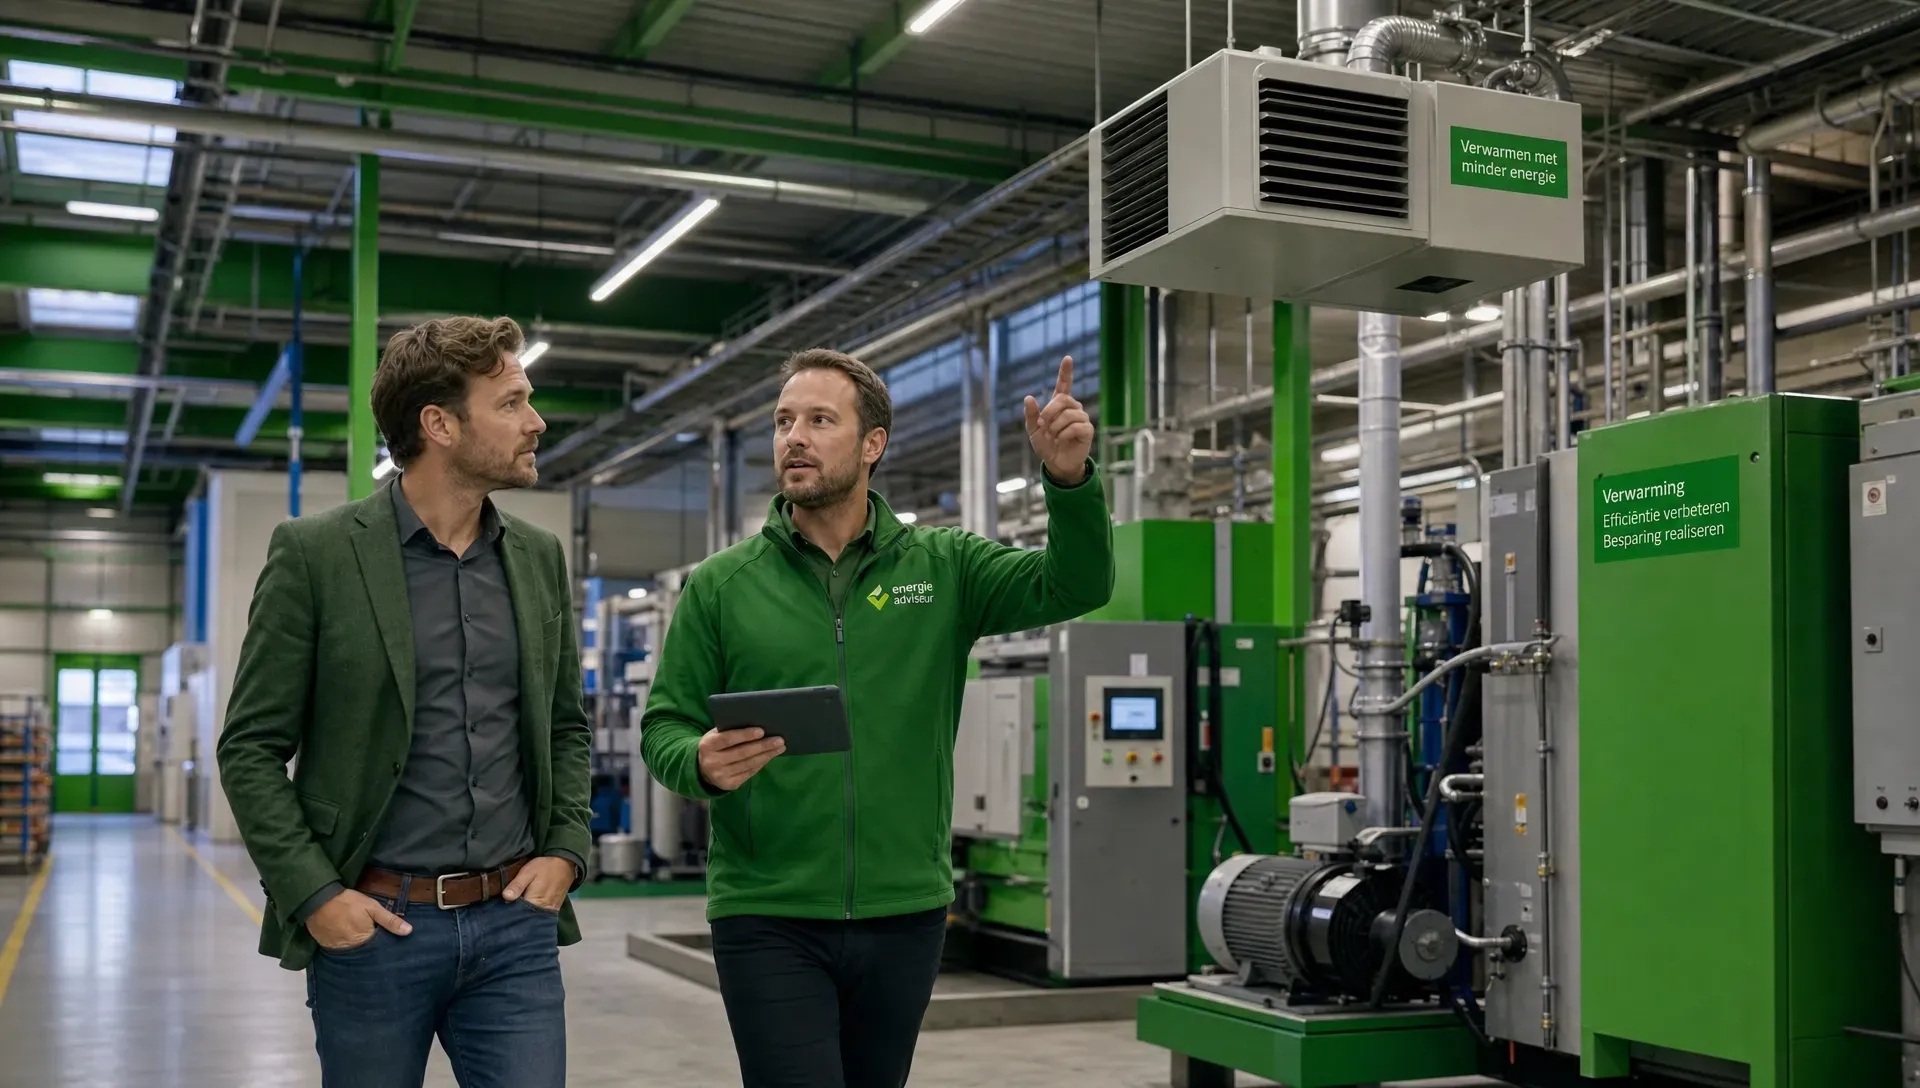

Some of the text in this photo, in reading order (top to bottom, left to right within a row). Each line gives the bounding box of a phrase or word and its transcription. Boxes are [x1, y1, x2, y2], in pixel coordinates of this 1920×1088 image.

[1460, 139, 1558, 166] Verwarmen met
[1462, 160, 1556, 186] minder energie
[1603, 480, 1685, 504] Verwarming
[1663, 501, 1730, 520] verbeteren
[1603, 523, 1724, 550] Besparing realiseren
[892, 580, 933, 594] energie
[893, 592, 934, 605] adviseur
